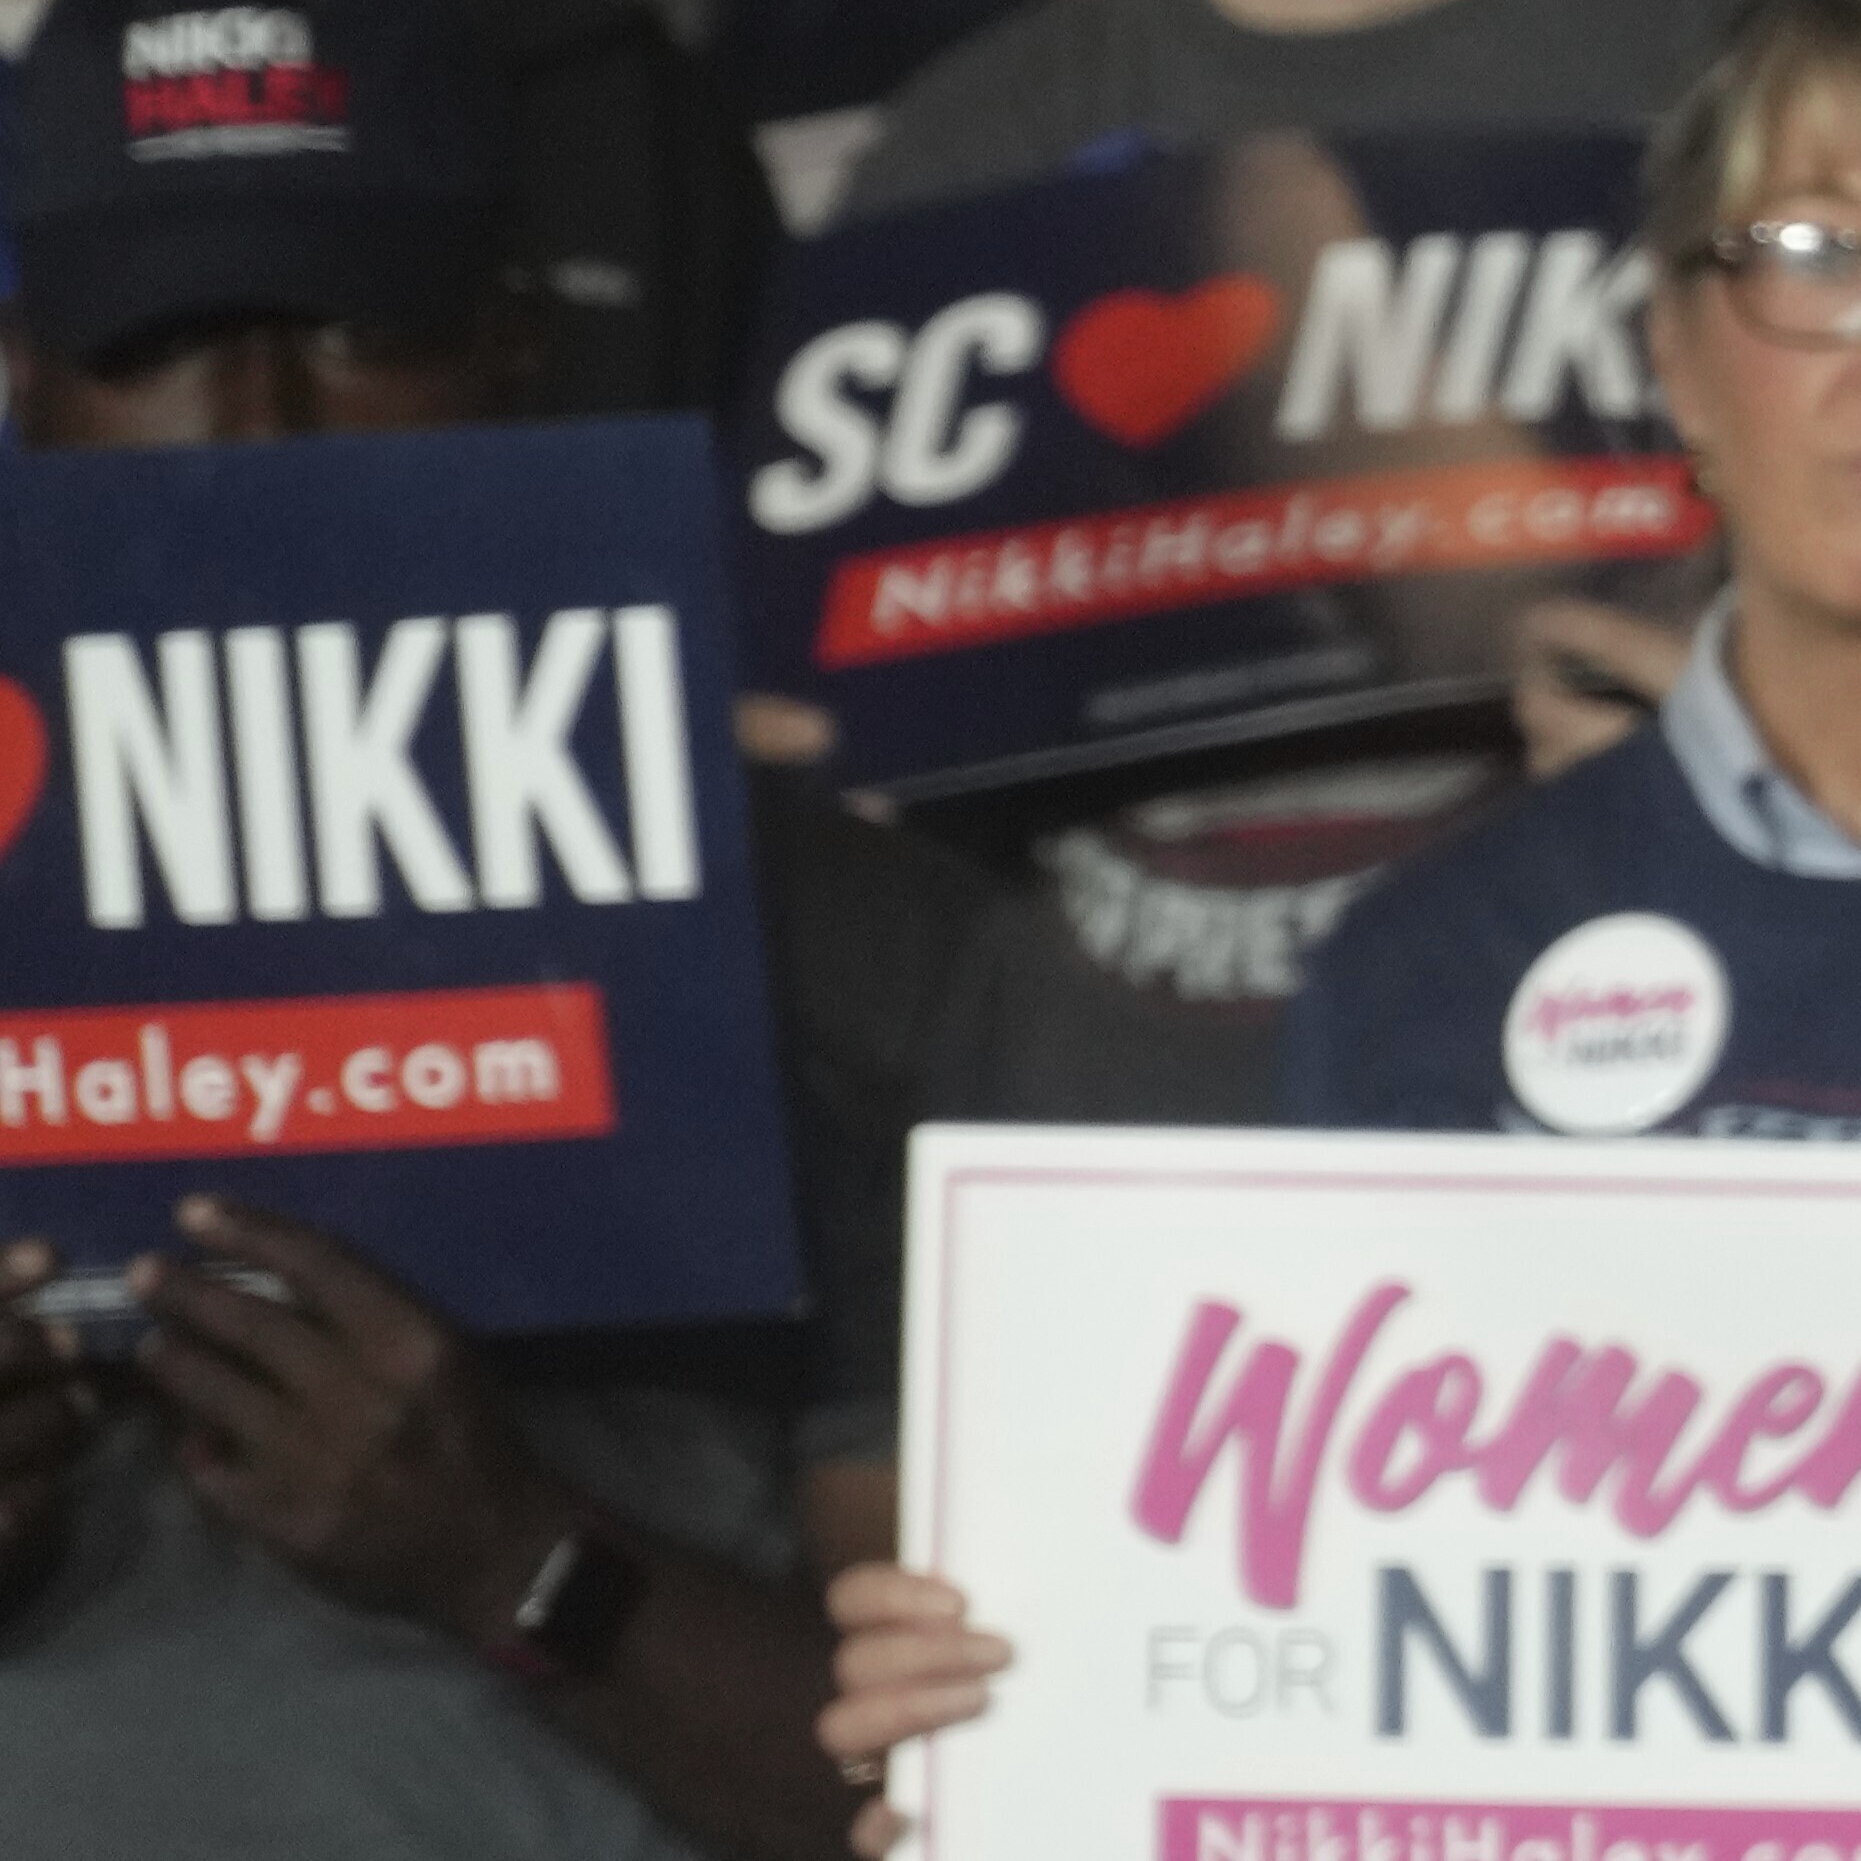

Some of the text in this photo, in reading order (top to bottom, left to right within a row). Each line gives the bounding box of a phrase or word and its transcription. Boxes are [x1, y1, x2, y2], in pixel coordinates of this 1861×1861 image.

[747, 228, 1672, 535] SC NIK
[868, 485, 1681, 638] NikkiHaley.com
[62, 603, 703, 930] NIKKI
[0, 1021, 562, 1143] Haley.com
[1144, 1625, 1336, 1720] FOR
